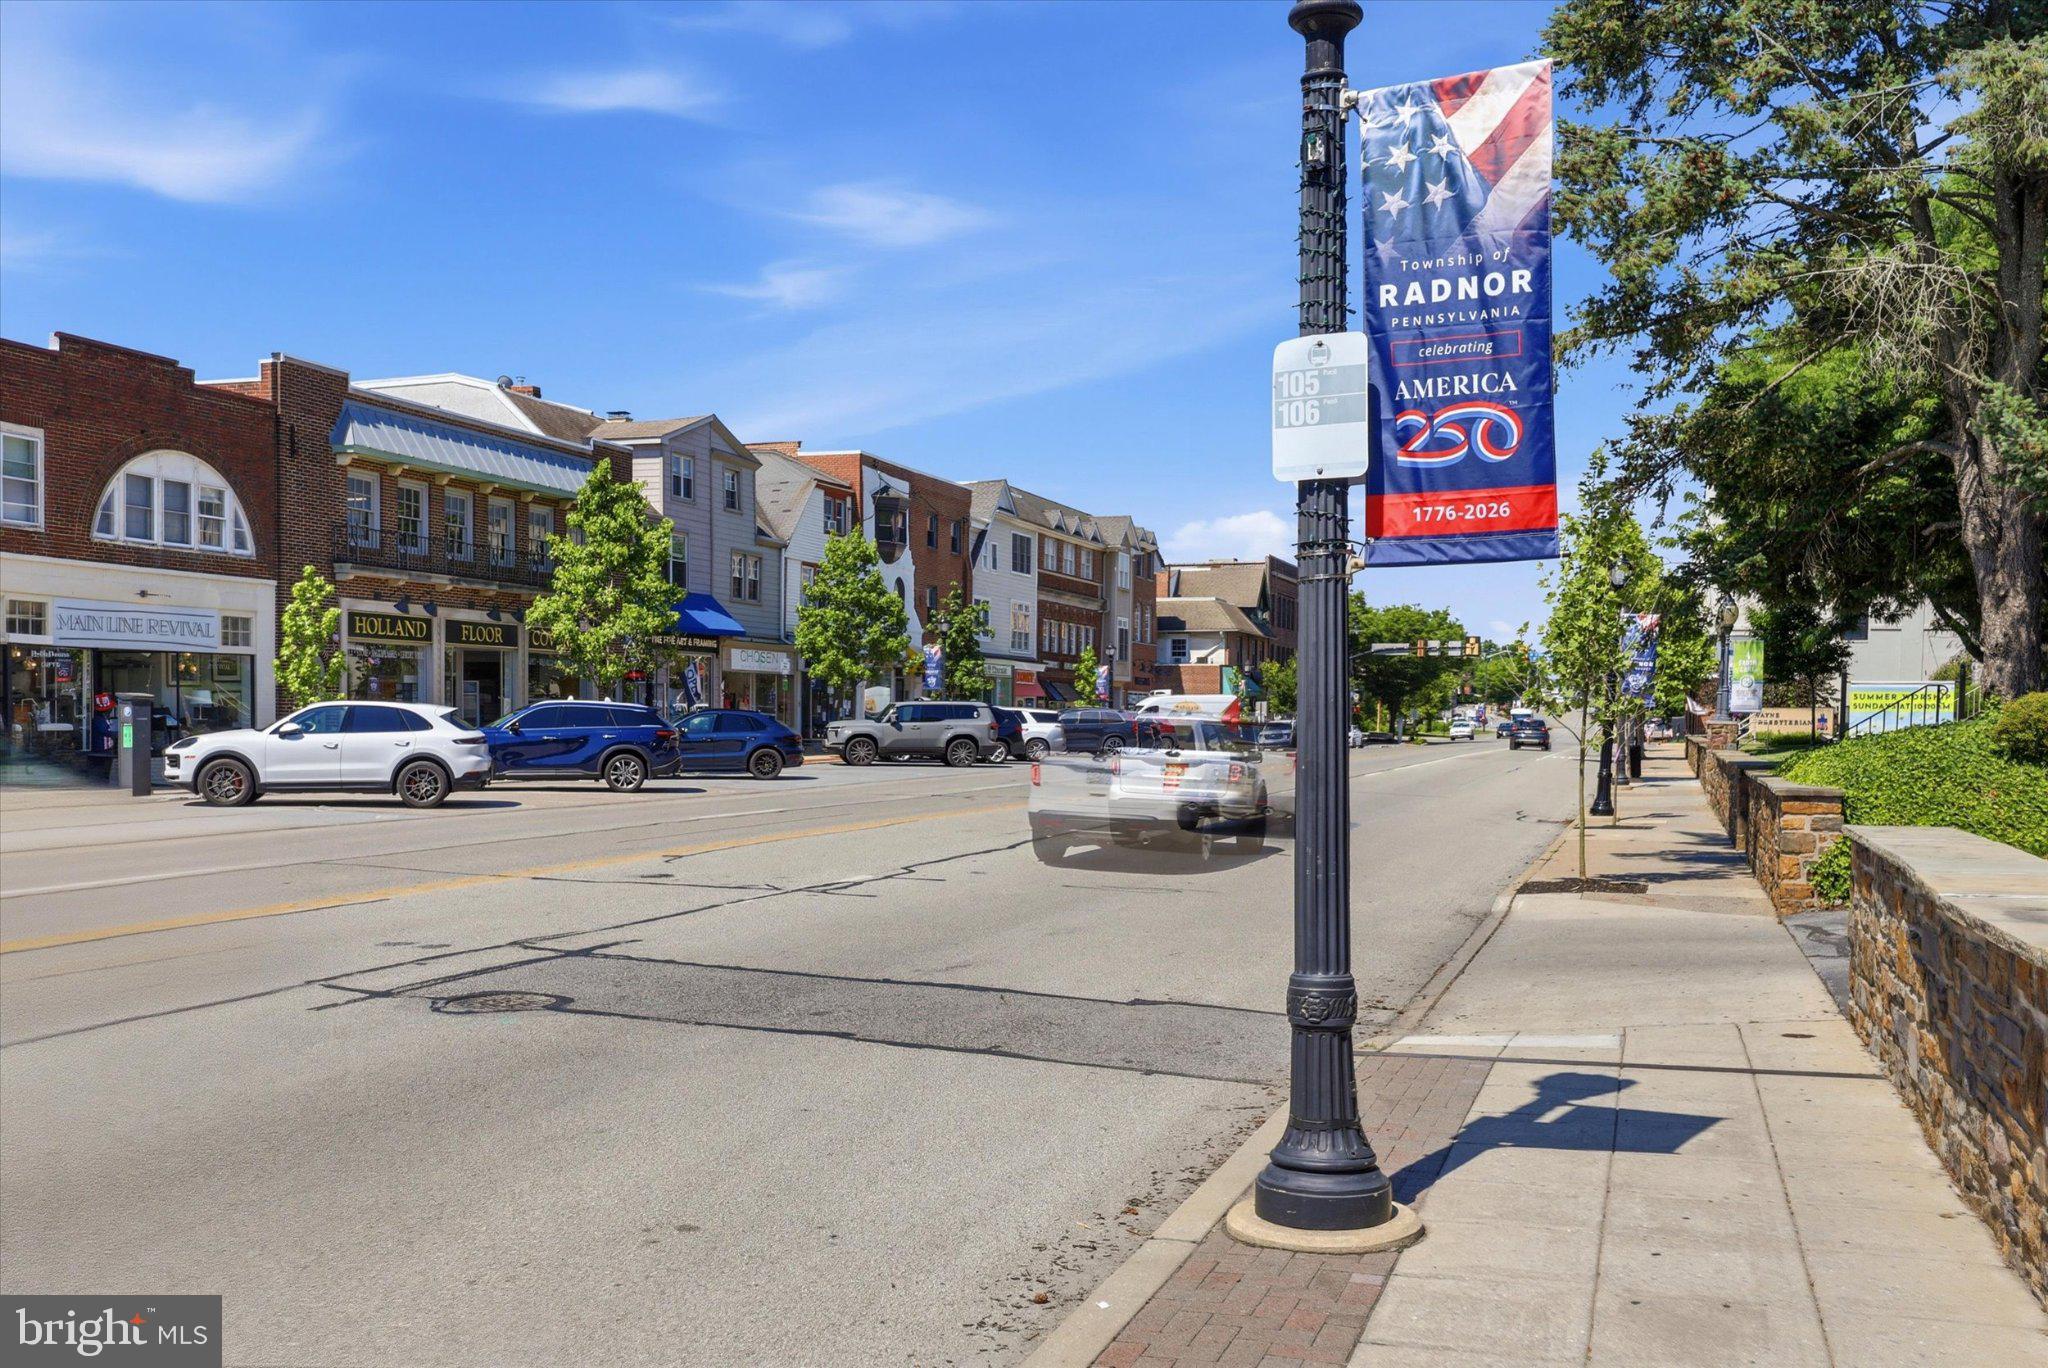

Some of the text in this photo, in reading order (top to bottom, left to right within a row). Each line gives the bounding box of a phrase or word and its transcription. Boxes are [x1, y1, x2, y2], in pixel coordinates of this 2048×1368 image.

[1400, 247, 1510, 272] Township of
[1379, 269, 1533, 308] RADNOR
[1391, 306, 1520, 328] PENNSYLVANIA
[1418, 342, 1493, 357] celebrating
[1278, 370, 1320, 398] 105
[1395, 371, 1517, 400] AMERICA
[1278, 400, 1320, 427] 106
[1395, 401, 1523, 468] 250
[1412, 502, 1511, 522] 1776-2026
[57, 614, 215, 638] MAIN LINE REVIVAL
[354, 616, 427, 638] HOLLAND
[461, 624, 503, 643] FLOOR
[740, 649, 779, 664] CHOSEN
